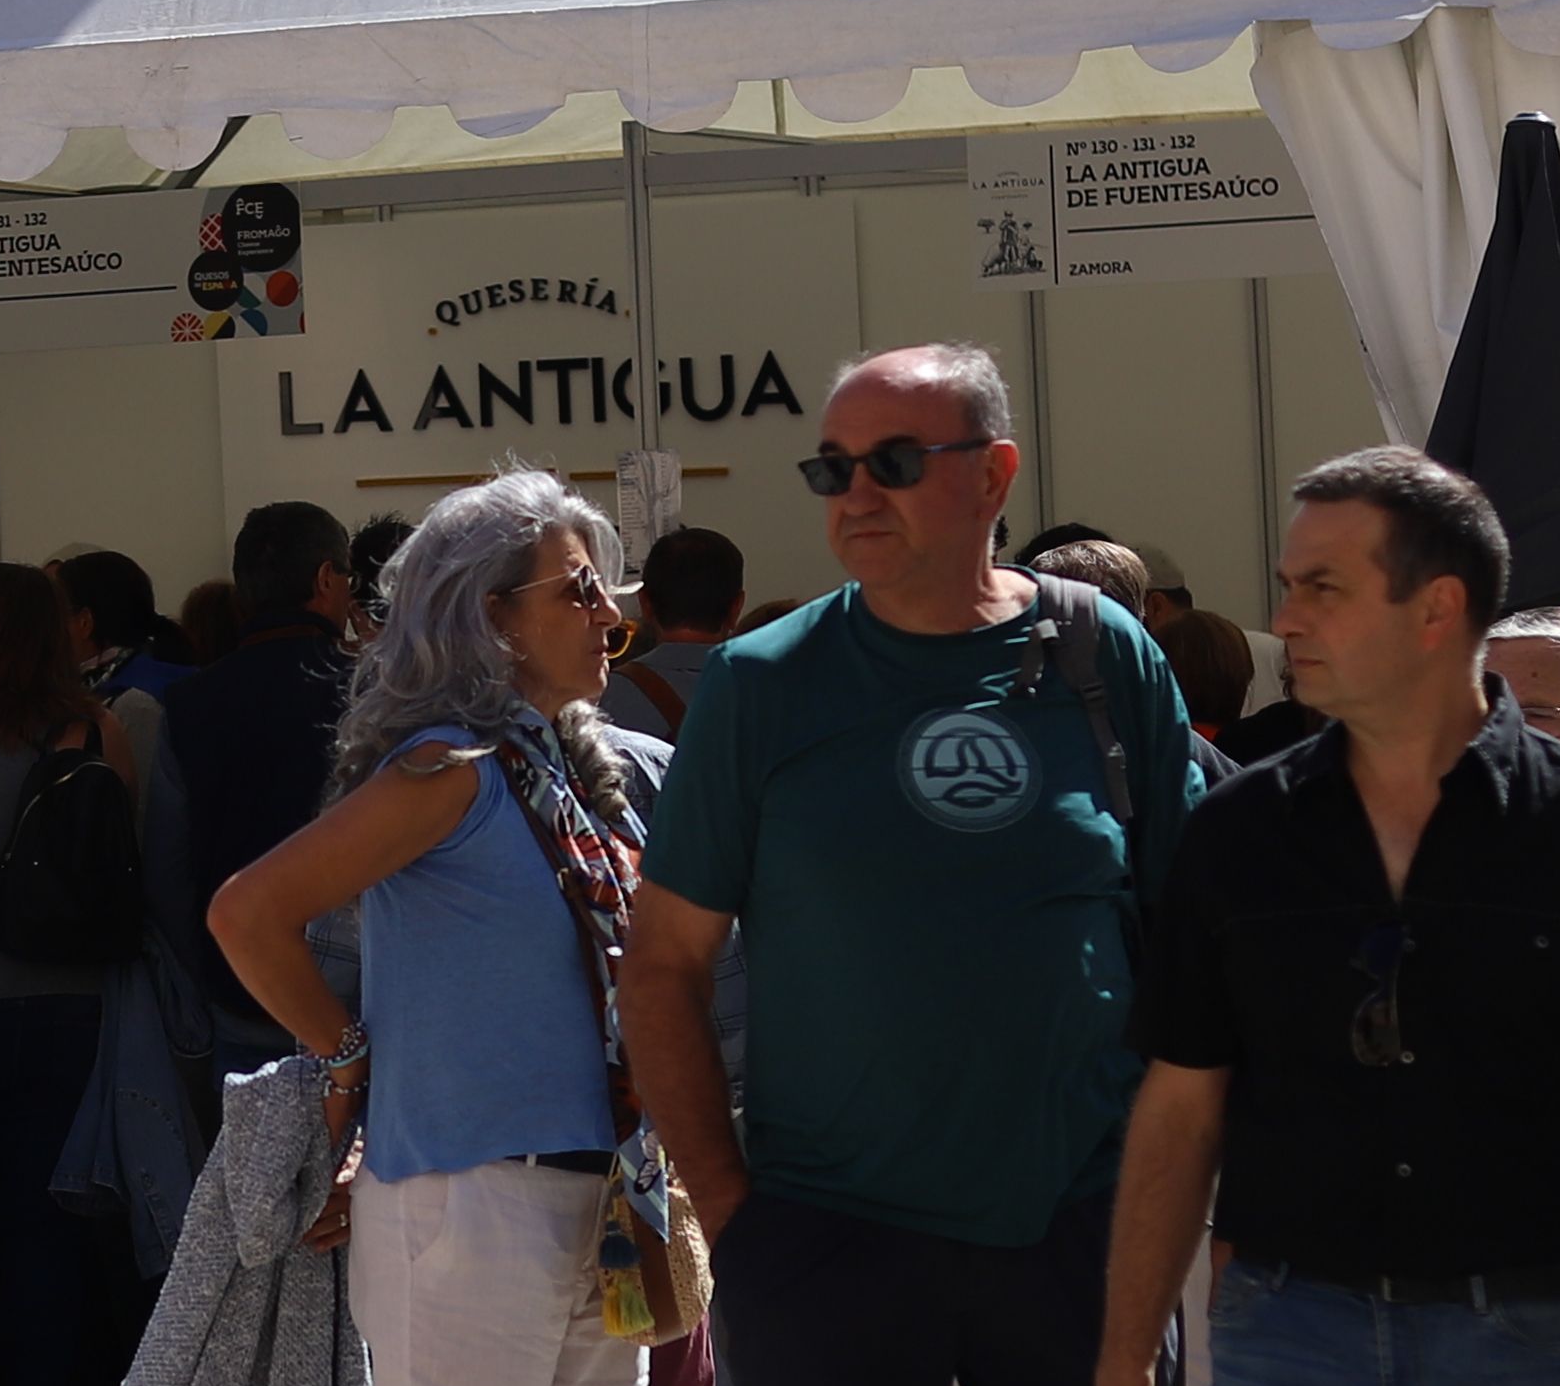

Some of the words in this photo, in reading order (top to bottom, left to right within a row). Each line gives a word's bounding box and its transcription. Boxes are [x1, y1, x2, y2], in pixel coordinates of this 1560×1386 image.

[1066, 141, 1087, 156] Nº
[1092, 140, 1118, 155] 130
[1133, 138, 1155, 152] 131
[1170, 135, 1195, 149] 132
[1066, 164, 1096, 184] LA
[1103, 157, 1210, 181] ANTIGUA
[1067, 190, 1098, 208] DE
[1105, 174, 1279, 206] FUENTESAÚCO
[24, 213, 47, 227] 132
[194, 271, 229, 282] QUESOS
[1069, 261, 1132, 277] ZAMORA
[434, 277, 618, 327] QUESERÍA
[278, 368, 394, 436] LA
[413, 349, 803, 431] ANTIGUA
